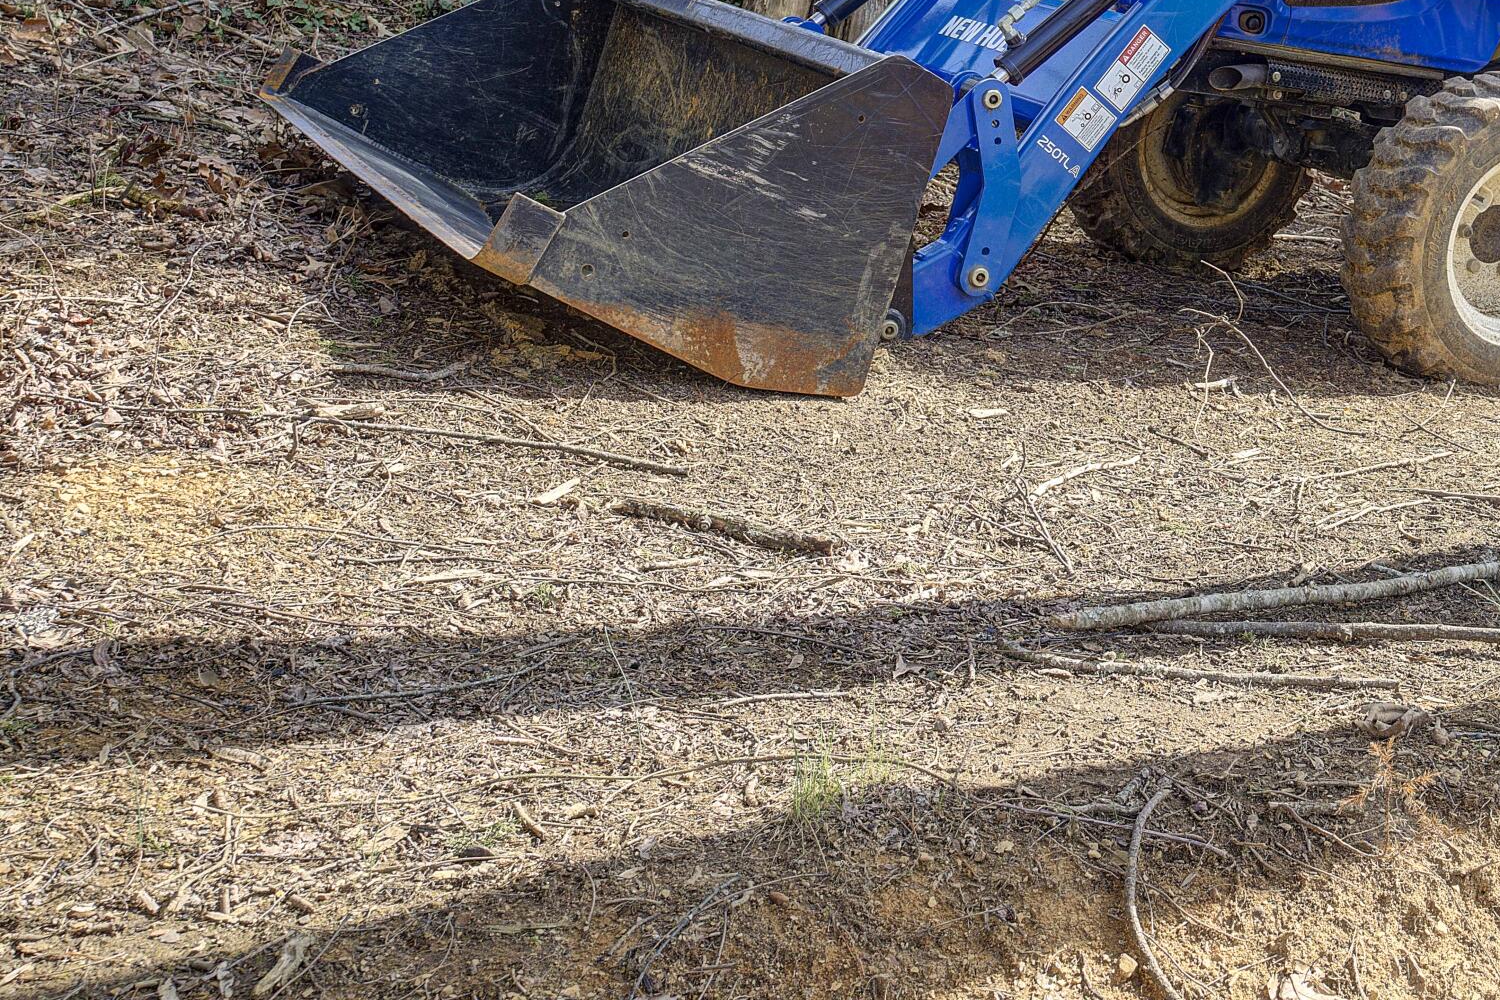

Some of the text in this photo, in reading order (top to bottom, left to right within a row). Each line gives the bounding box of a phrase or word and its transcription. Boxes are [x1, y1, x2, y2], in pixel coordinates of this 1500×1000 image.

[938, 15, 988, 42] NEW
[1126, 29, 1148, 56] DANGER
[1065, 92, 1086, 116] WARNING
[1036, 134, 1081, 179] 250TLA
